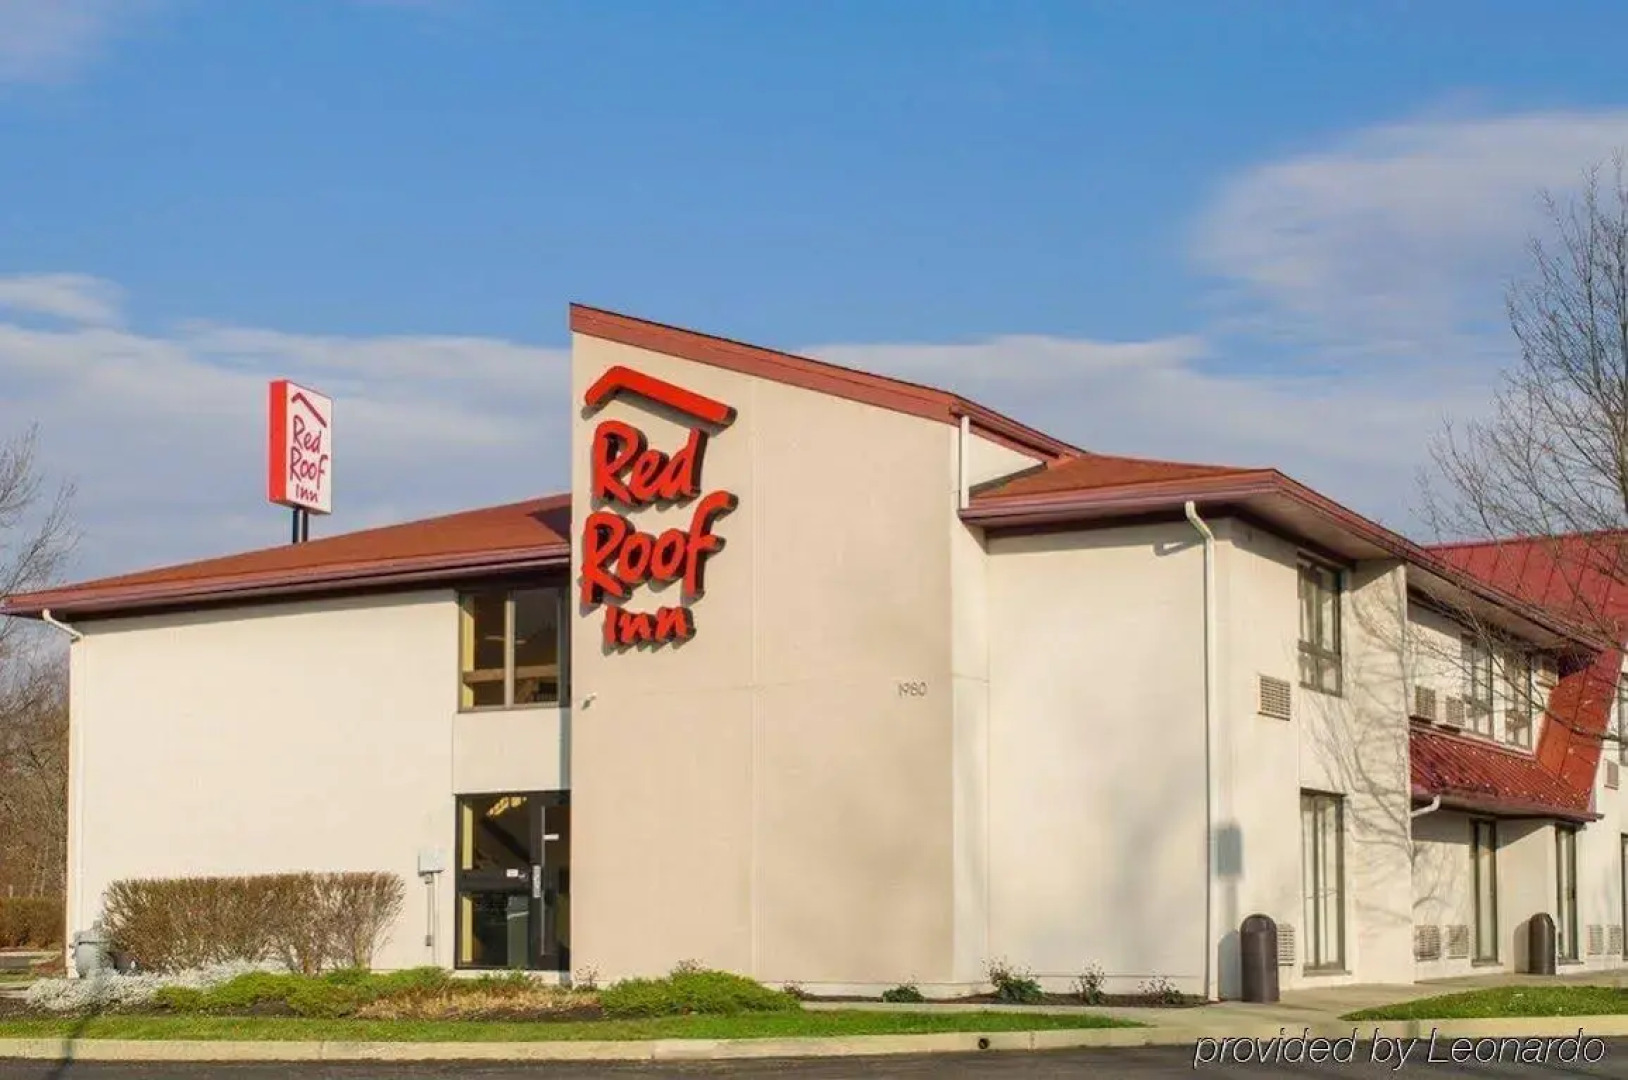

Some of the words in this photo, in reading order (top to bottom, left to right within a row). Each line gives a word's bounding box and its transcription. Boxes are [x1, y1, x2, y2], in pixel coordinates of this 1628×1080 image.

[293, 415, 322, 453] Red
[290, 446, 328, 490] Roof
[592, 420, 706, 505] Red
[580, 490, 736, 604] Roof
[602, 604, 694, 645] Inn
[898, 681, 927, 697] 1980
